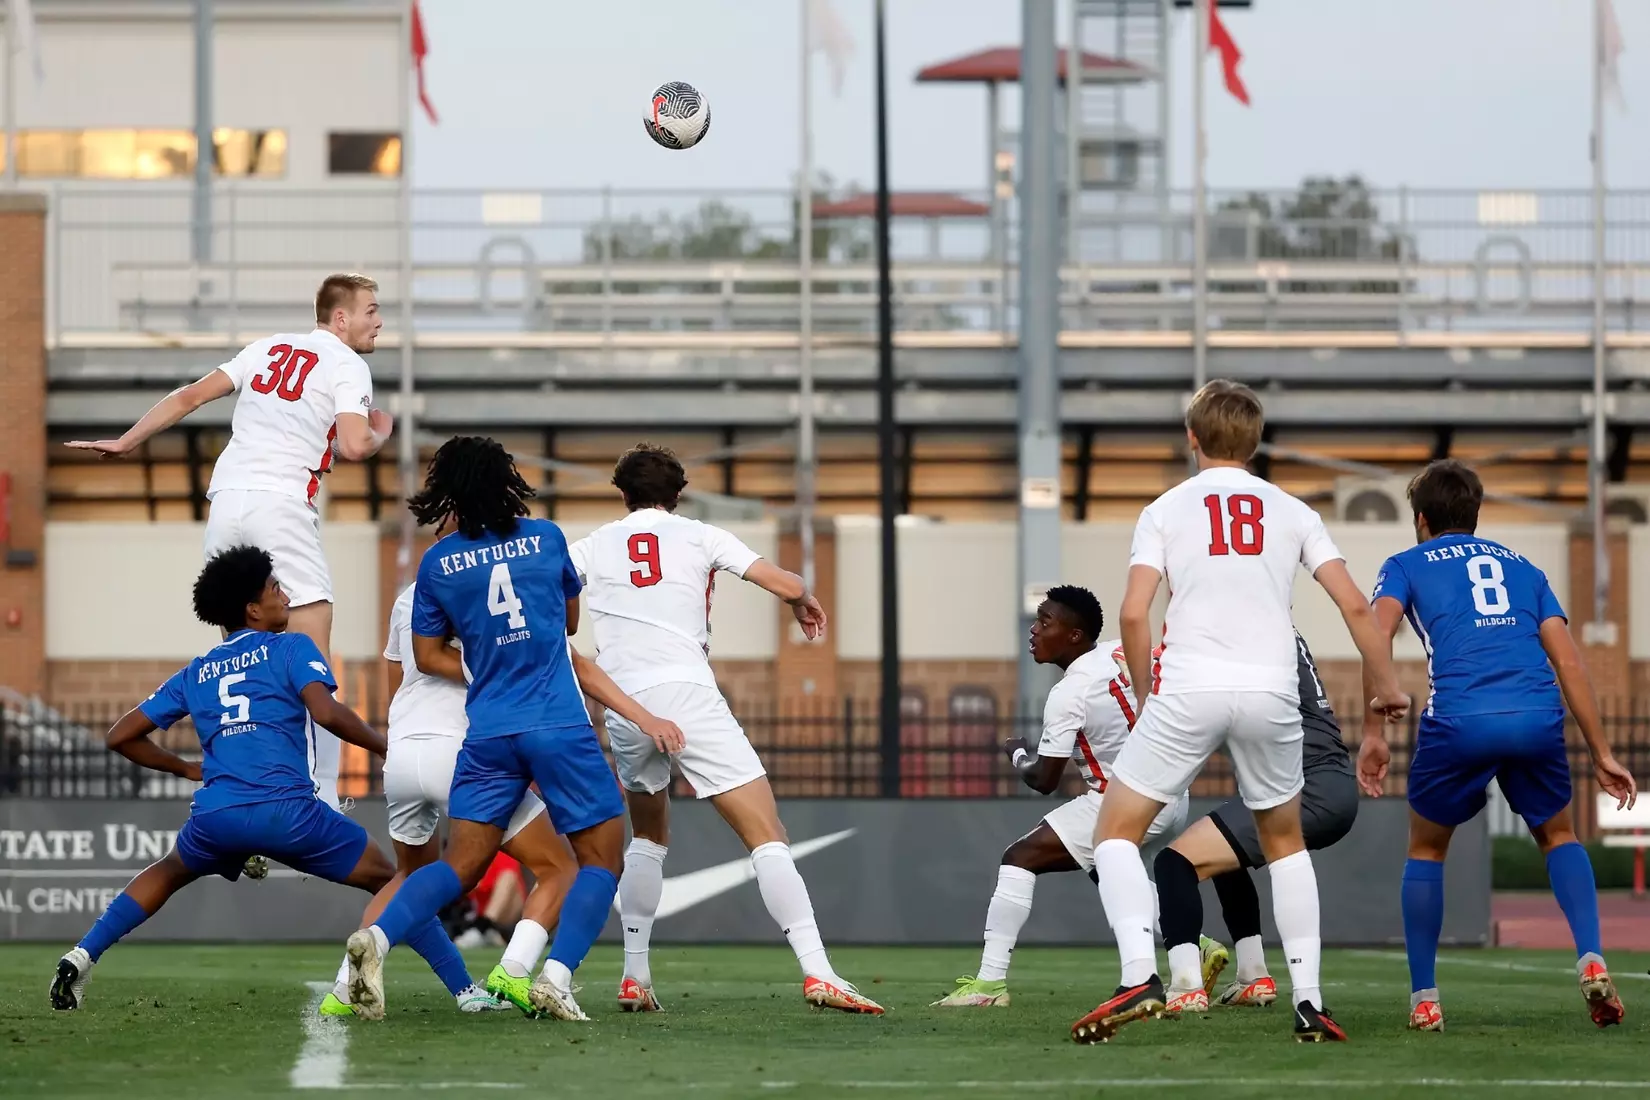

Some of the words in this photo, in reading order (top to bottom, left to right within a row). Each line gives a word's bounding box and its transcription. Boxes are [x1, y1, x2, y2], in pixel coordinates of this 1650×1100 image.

[250, 343, 319, 402] 30
[1203, 493, 1264, 556] 18
[440, 535, 541, 575] KENTUCKY
[627, 532, 662, 588] 9
[1424, 543, 1523, 564] KENTUCKY
[487, 562, 526, 630] 4
[1465, 554, 1511, 616] 8
[1474, 616, 1516, 628] WILDCATS
[198, 644, 269, 684] KENTUCKY
[218, 671, 250, 725] 5
[222, 723, 257, 738] WILDCATS
[0, 830, 94, 860] TATE
[27, 887, 124, 914] CENTE
